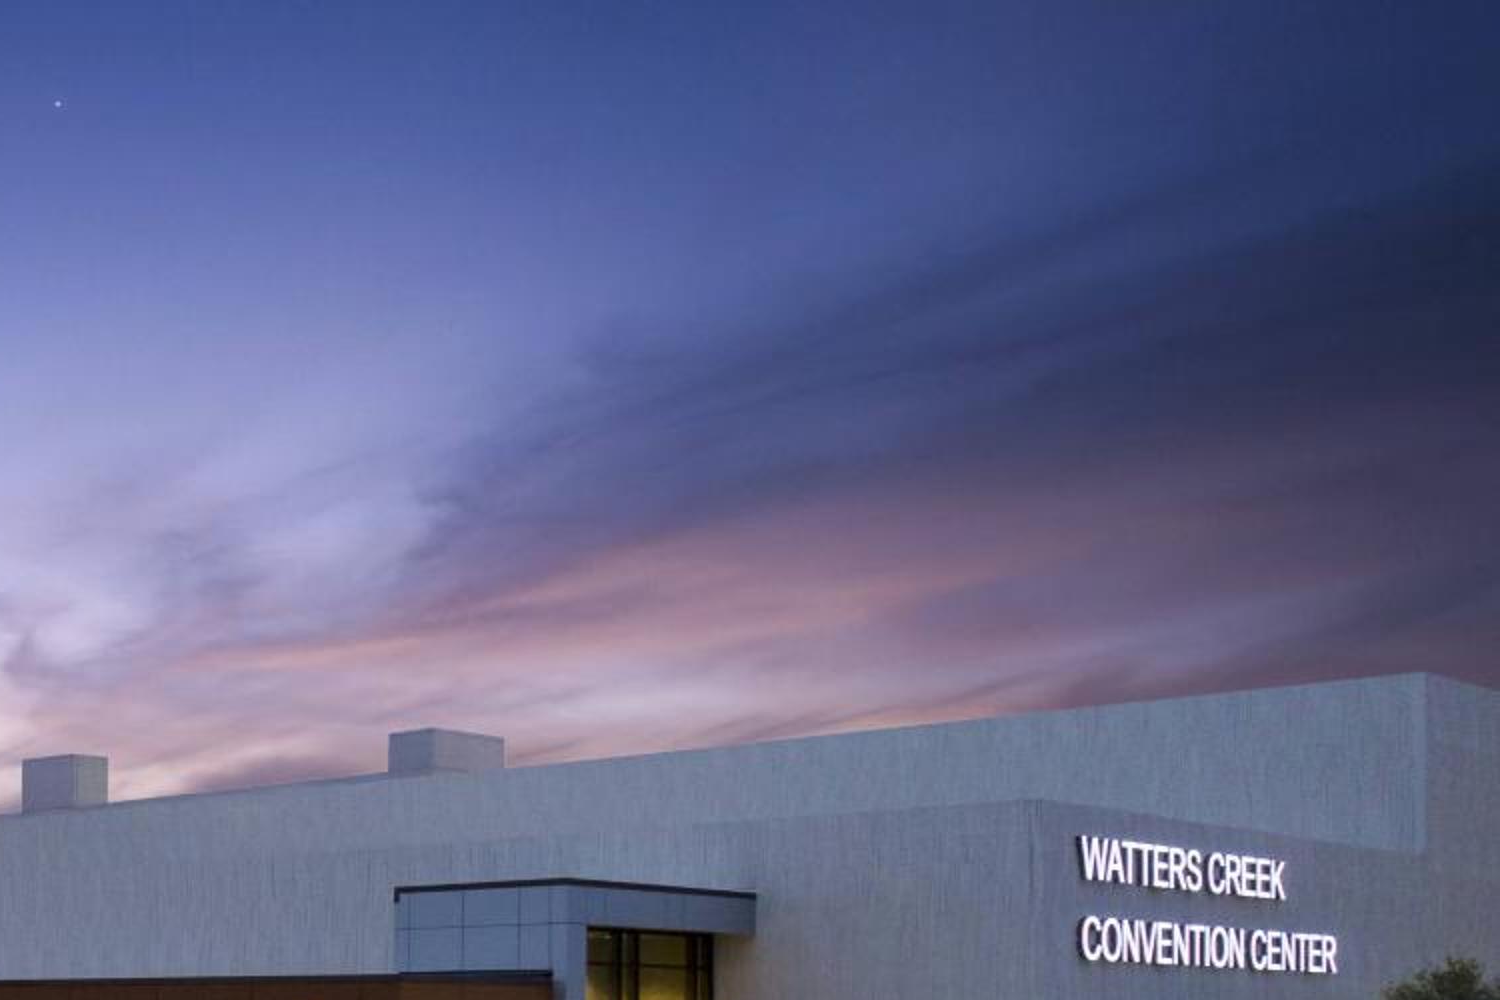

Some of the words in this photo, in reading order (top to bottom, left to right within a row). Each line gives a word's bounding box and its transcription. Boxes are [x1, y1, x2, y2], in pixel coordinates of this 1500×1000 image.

[1079, 835, 1201, 892] WATTERS
[1207, 852, 1287, 900] CREEK
[1080, 915, 1246, 969] CONVENTION
[1250, 930, 1338, 974] CENTER
